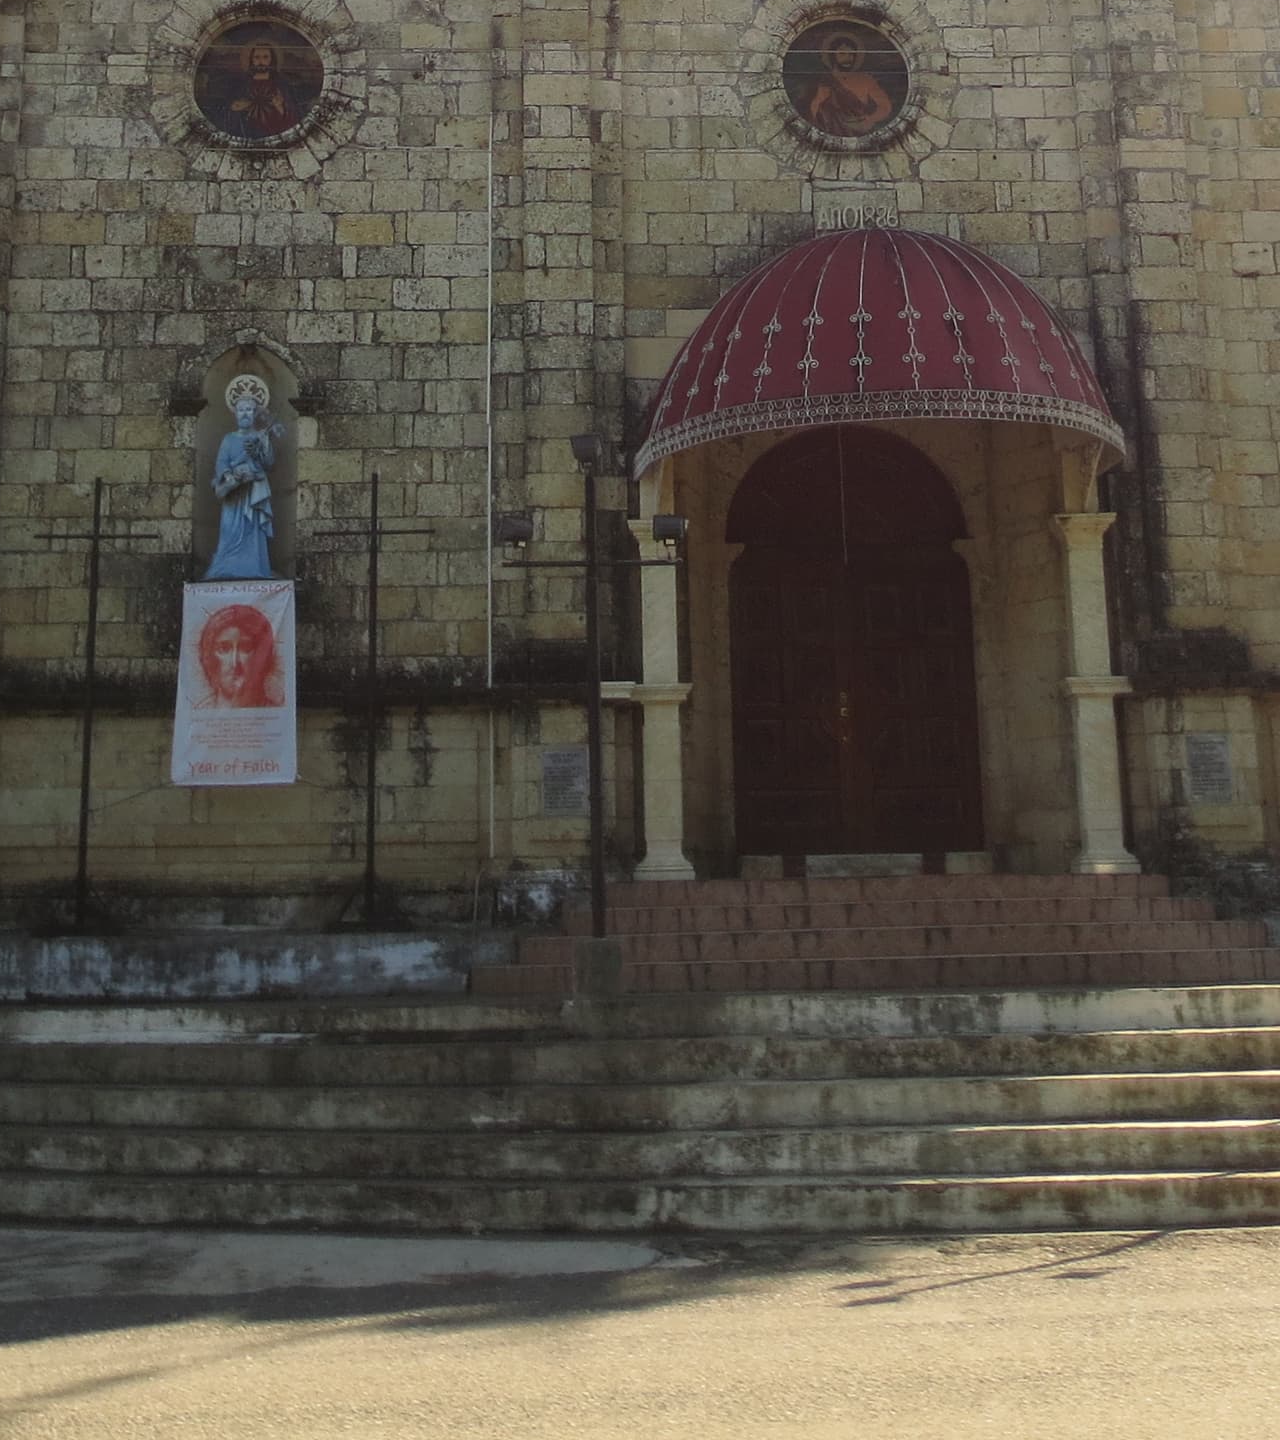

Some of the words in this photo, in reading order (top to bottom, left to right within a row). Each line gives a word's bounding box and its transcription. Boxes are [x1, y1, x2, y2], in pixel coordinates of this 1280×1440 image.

[188, 761, 217, 777] Year
[223, 758, 239, 776] of
[242, 759, 280, 774] Faith
